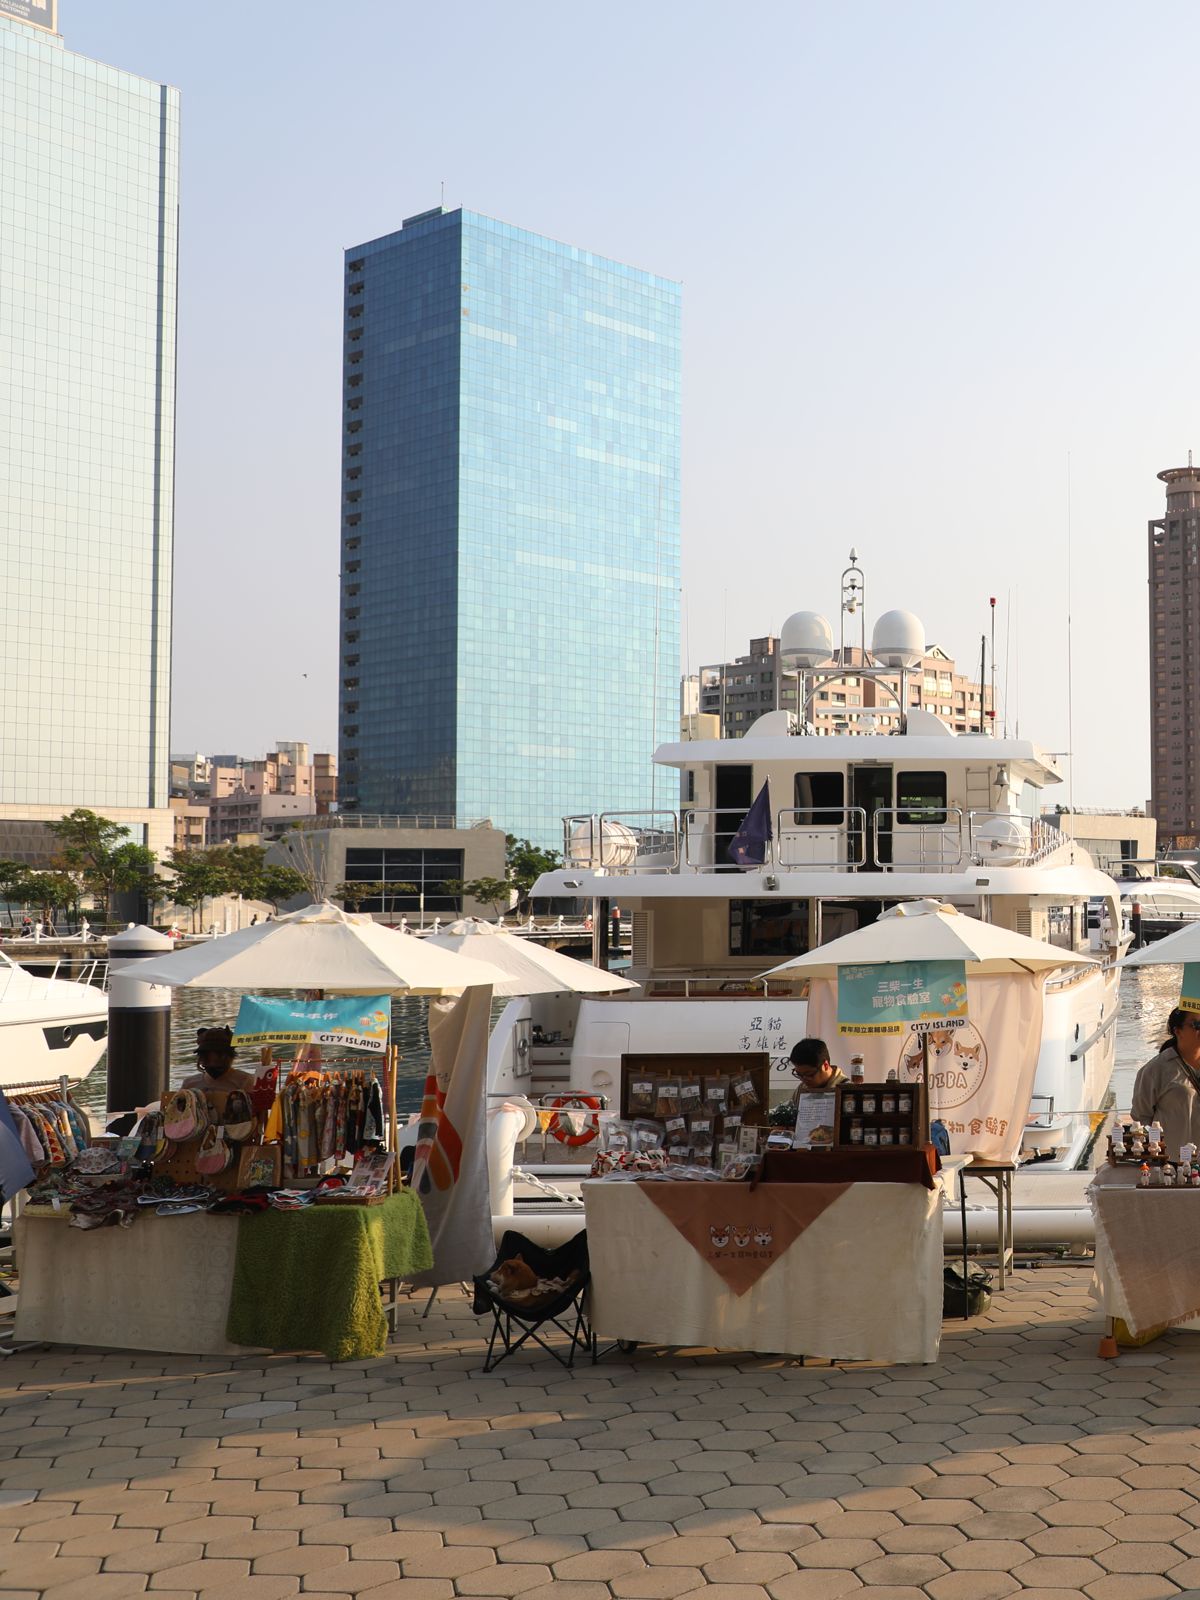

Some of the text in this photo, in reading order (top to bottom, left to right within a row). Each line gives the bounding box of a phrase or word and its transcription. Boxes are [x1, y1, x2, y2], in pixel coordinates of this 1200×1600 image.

[877, 978, 924, 993] 三柴一生
[910, 1018, 965, 1032] CITY ISLAND
[319, 1034, 382, 1049] CITY ISLAND
[738, 1035, 788, 1051] 高雄港
